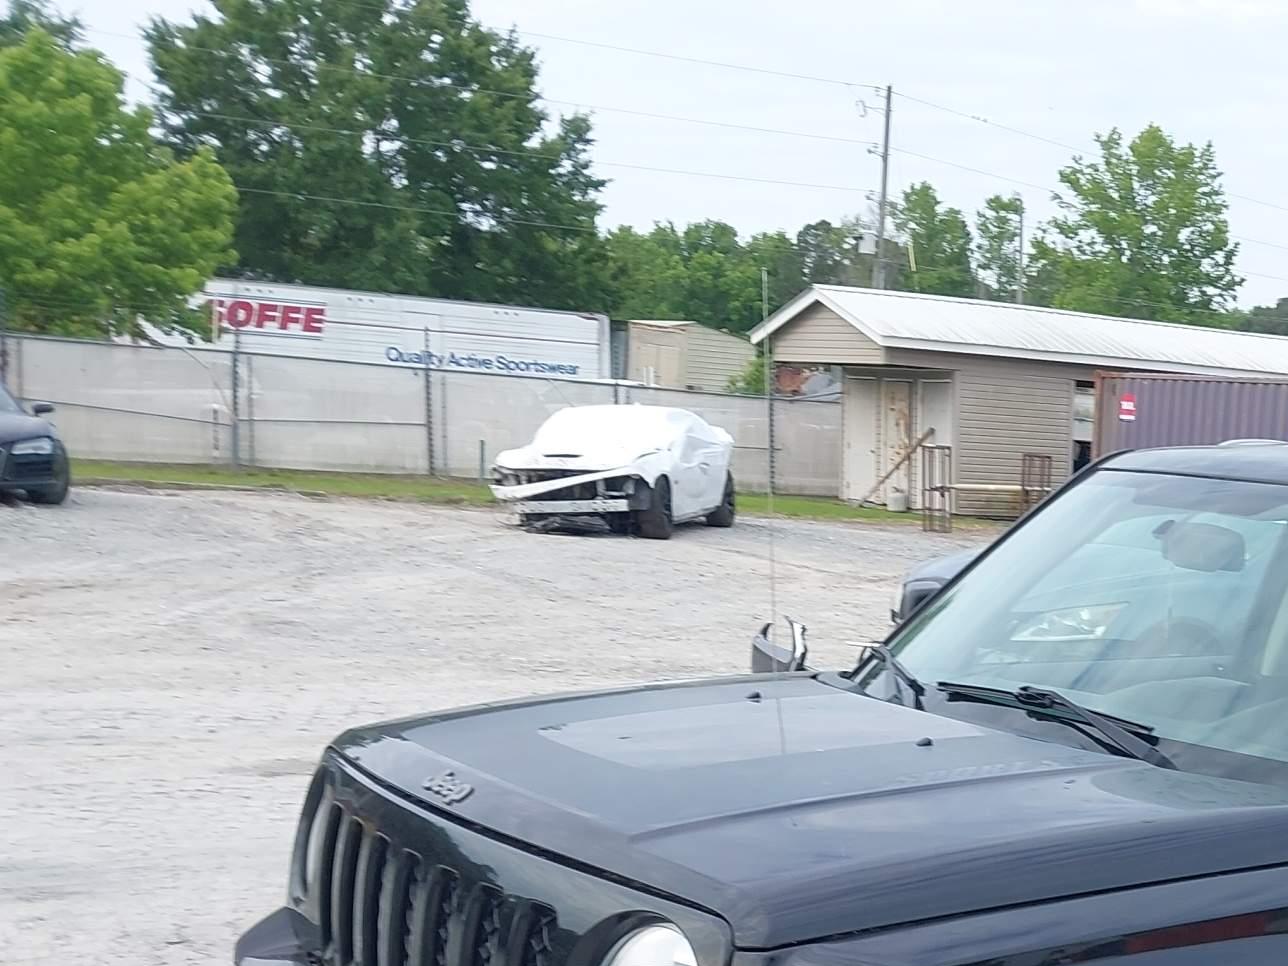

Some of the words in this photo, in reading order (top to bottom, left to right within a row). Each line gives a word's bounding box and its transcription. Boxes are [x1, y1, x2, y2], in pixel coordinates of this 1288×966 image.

[385, 346, 444, 368] Quality
[448, 352, 493, 371] Active
[495, 355, 580, 375] Sportswear
[422, 769, 475, 806] Jeep
